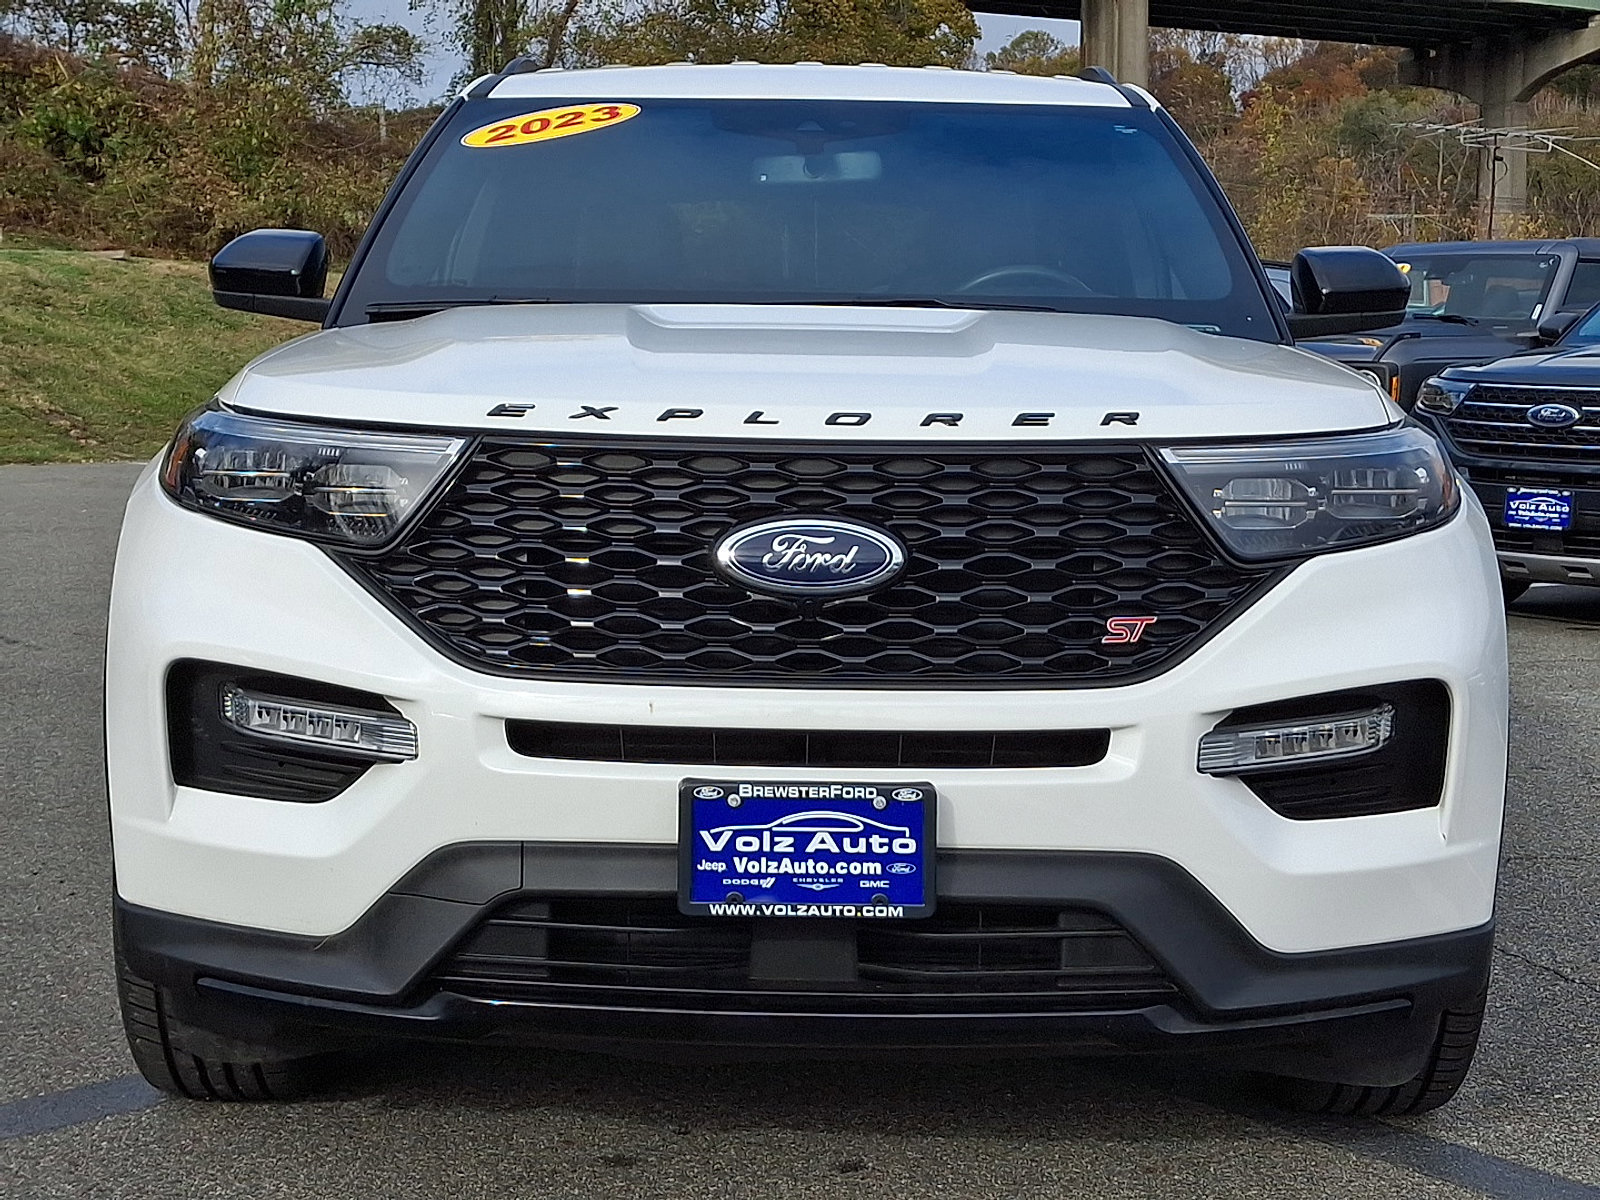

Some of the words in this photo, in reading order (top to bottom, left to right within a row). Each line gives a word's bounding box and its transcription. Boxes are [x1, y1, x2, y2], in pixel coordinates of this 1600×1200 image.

[485, 105, 622, 144] 2023
[486, 403, 1140, 427] EXPLORER
[1538, 503, 1570, 513] Auto
[762, 533, 859, 574] Ford
[1101, 616, 1158, 644] ST
[699, 830, 795, 853] Volz
[805, 831, 917, 854] Auto
[697, 859, 727, 873] Jeep
[733, 856, 882, 875] VolzAuto.com
[859, 880, 890, 888] GMC
[709, 903, 904, 918] WWW.VOLZAUTO.COM
